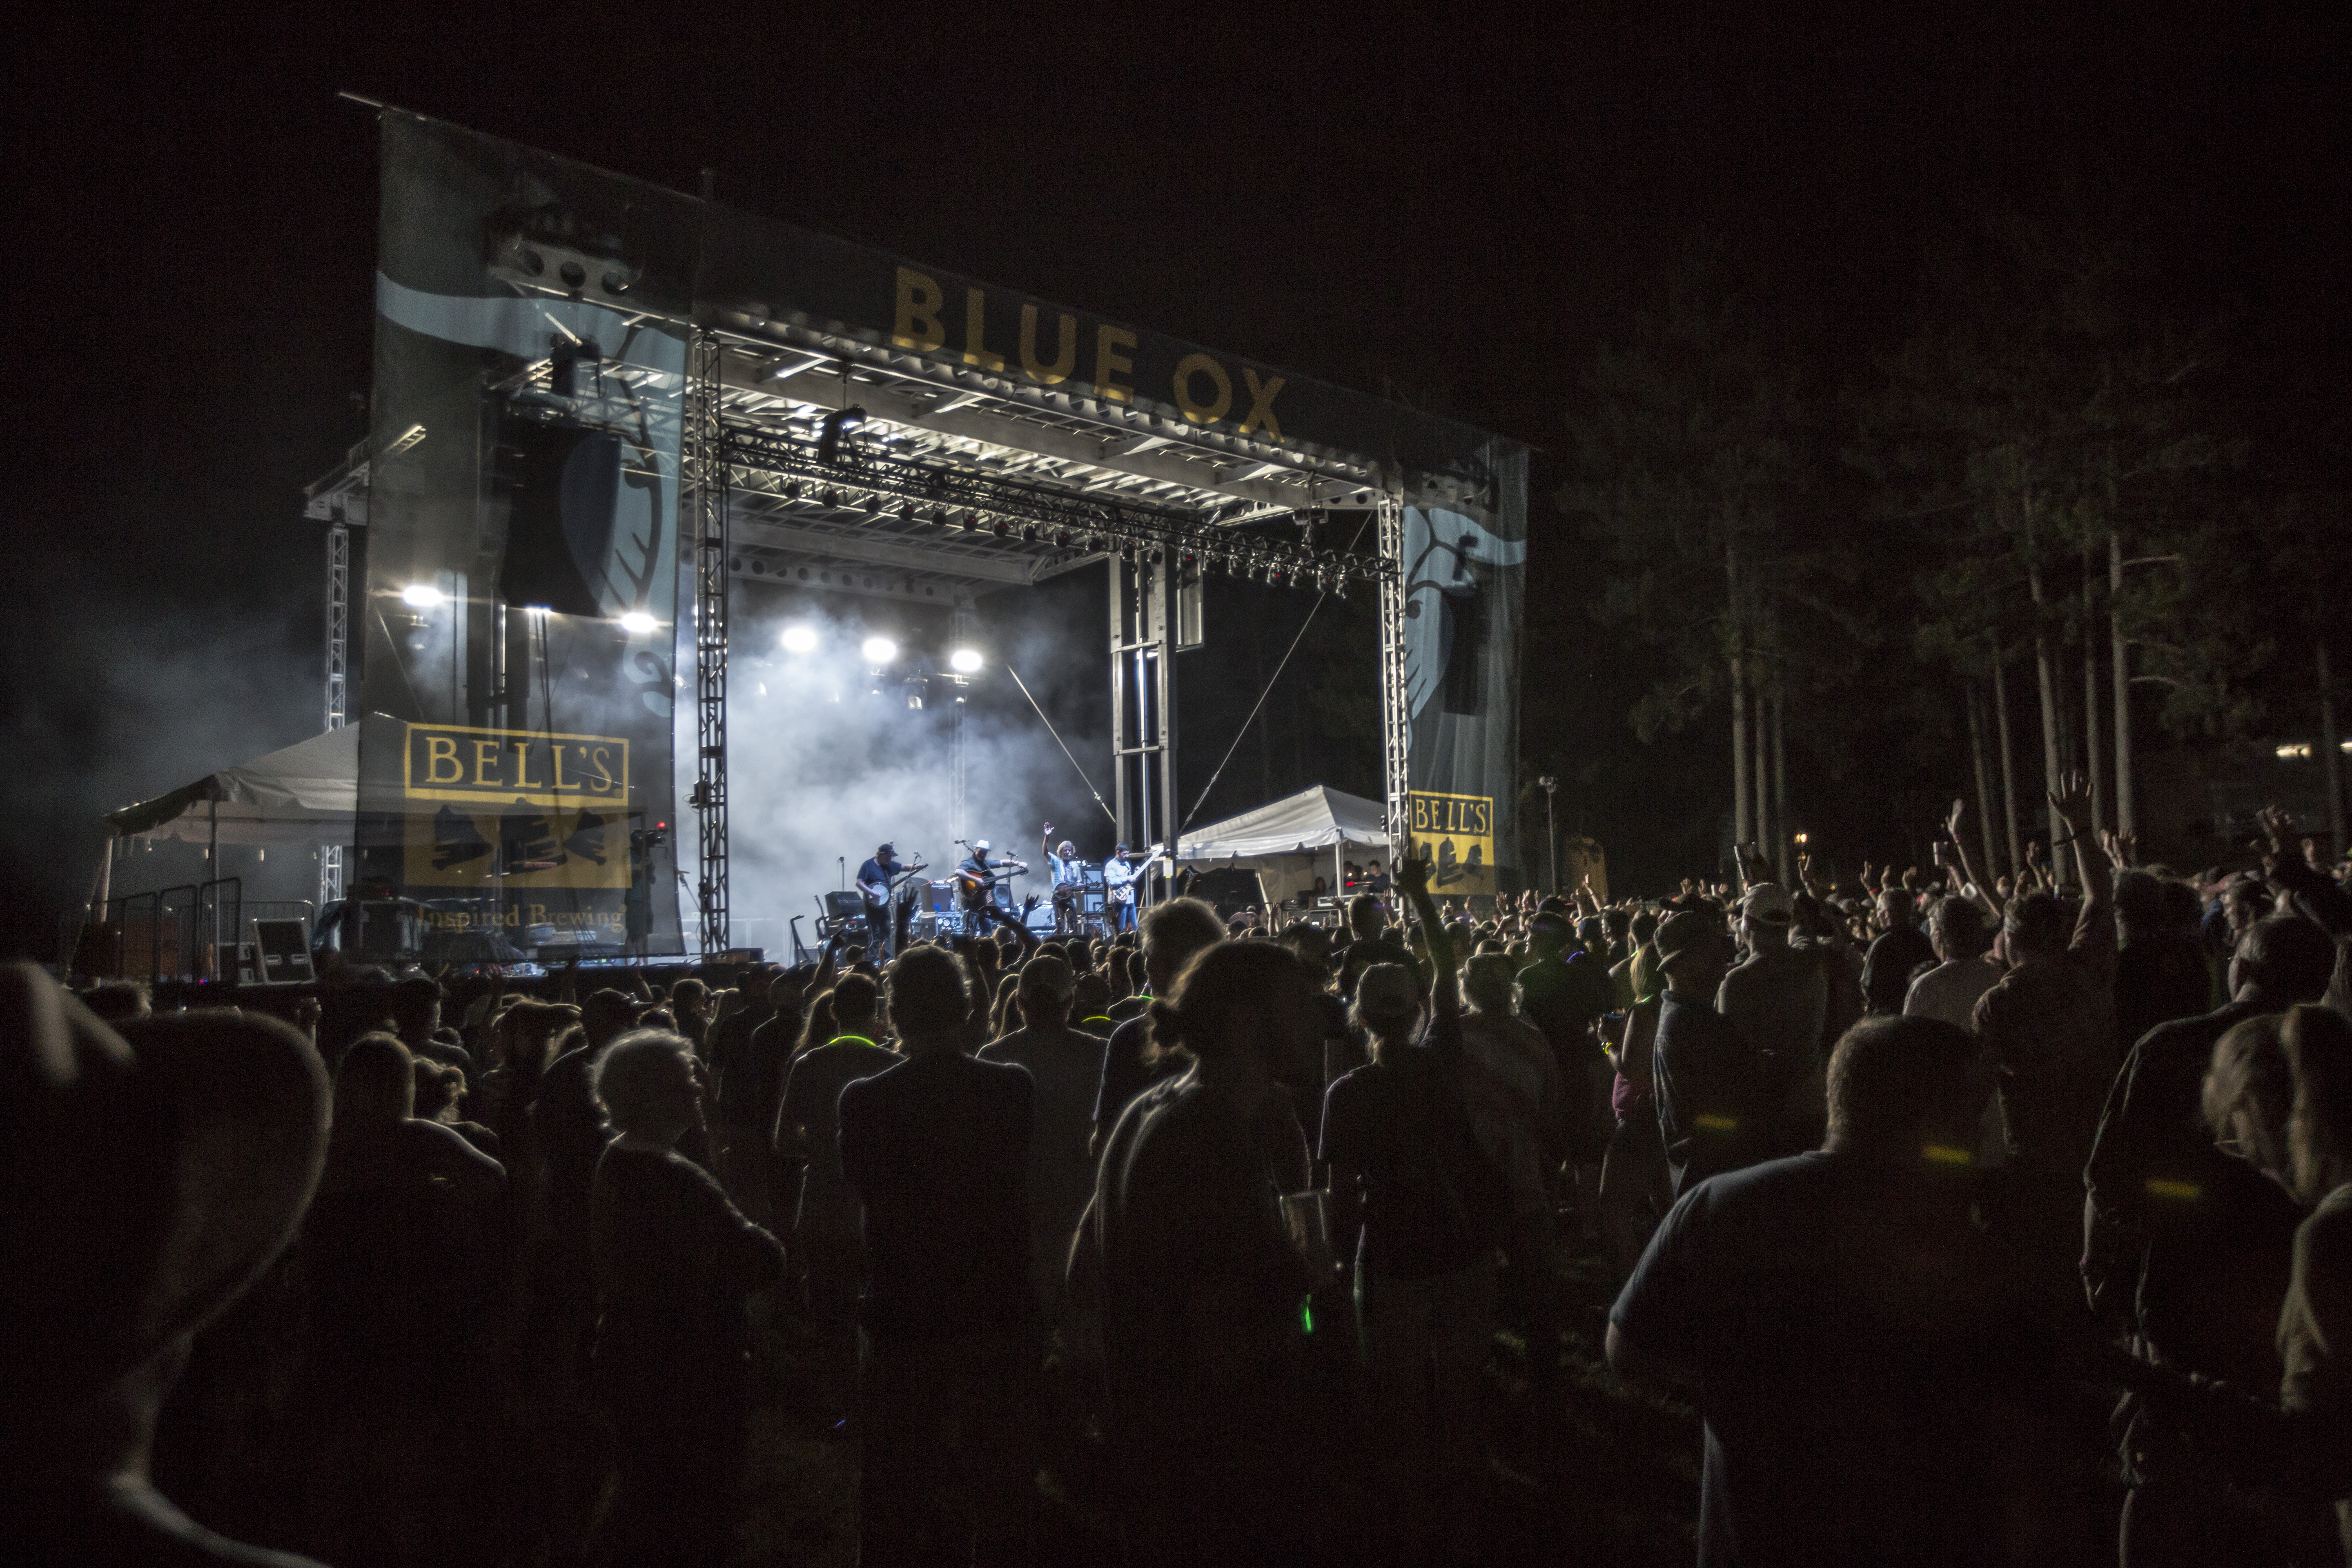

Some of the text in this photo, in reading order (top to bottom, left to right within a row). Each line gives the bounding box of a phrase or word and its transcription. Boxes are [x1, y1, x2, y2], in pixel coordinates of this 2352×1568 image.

[893, 266, 1285, 443] BLUE OX
[425, 737, 612, 792] BELL'S
[1416, 799, 1486, 833] BELL'S
[418, 903, 626, 933] Inspired Brewing
